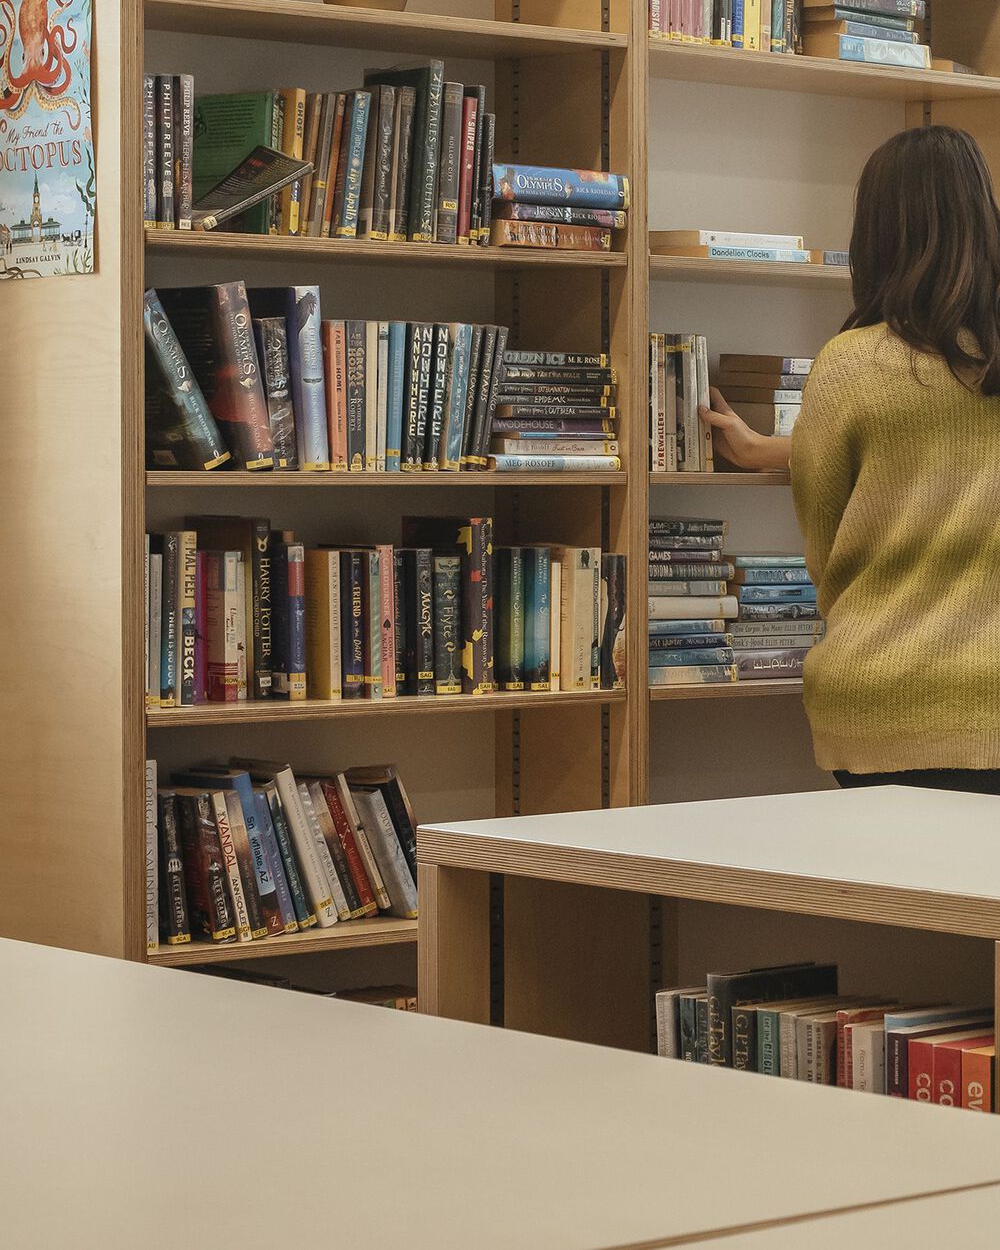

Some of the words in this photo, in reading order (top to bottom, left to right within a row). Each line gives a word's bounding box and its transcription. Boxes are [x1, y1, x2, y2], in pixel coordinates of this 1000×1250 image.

[146, 81, 154, 127] PHILIP
[163, 83, 171, 128] PHILIP
[183, 80, 192, 108] PHILIP
[6, 128, 20, 146] My
[22, 122, 50, 140] Friend
[183, 108, 191, 136] REEVE
[296, 101, 305, 139] GHOST
[429, 108, 439, 143] TALES
[0, 139, 82, 172] CTOPUS
[147, 133, 155, 175] REEVE
[163, 133, 172, 176] REEVE
[422, 161, 437, 217] PECULIAR
[516, 174, 564, 193] OLYMPUS
[444, 202, 456, 210] RIG
[15, 256, 39, 265] LINDSAY
[39, 253, 62, 263] GALVIN
[711, 248, 745, 258] Dandelion
[746, 250, 770, 259] Clocks
[157, 319, 189, 378] OLYMPUS
[235, 312, 256, 375] OLYMPUS
[334, 329, 342, 345] FAR
[348, 347, 356, 388] HORSE
[355, 347, 365, 388] GREAT
[503, 351, 544, 366] GREEN
[546, 352, 566, 366] ICE
[335, 366, 343, 393] HOME
[408, 326, 422, 437] ANYWHERE
[416, 327, 433, 437] NOWHERE
[431, 327, 449, 437] NOWHERE
[466, 373, 477, 411] LONDON
[480, 375, 490, 402] PARIS
[489, 376, 500, 411] MEXICO
[496, 419, 555, 430] WODEHOUSE
[504, 459, 522, 468] MEG
[524, 459, 557, 468] ROSOFF
[479, 523, 488, 548] Sunjeev
[184, 547, 196, 571] MAL
[480, 550, 488, 576] Sahota
[649, 550, 672, 561] GAMES
[183, 573, 195, 600] PEET
[259, 557, 272, 602] HARRY
[481, 579, 489, 593] The
[352, 586, 361, 618] FRIEND
[417, 589, 432, 637] MAGYK
[168, 610, 176, 640] THERE
[260, 607, 272, 658] POTTER
[440, 606, 454, 639] Flyte
[167, 650, 175, 663] NO
[182, 635, 195, 681] BECK
[480, 630, 490, 667] Runaways
[167, 664, 175, 686] DOG
[219, 816, 238, 873] VANDAL
[171, 874, 179, 893] ALEX
[212, 874, 221, 893] ALEX
[231, 876, 243, 896] ANN
[258, 869, 271, 884] AZ
[173, 895, 183, 928] SCARROW
[215, 896, 229, 929] SCARROW
[235, 896, 247, 928] SCHLEE
[221, 929, 233, 937] SCA
[734, 1046, 749, 1071] Tay
[859, 1048, 867, 1077] Roma
[967, 1080, 984, 1111] ev
